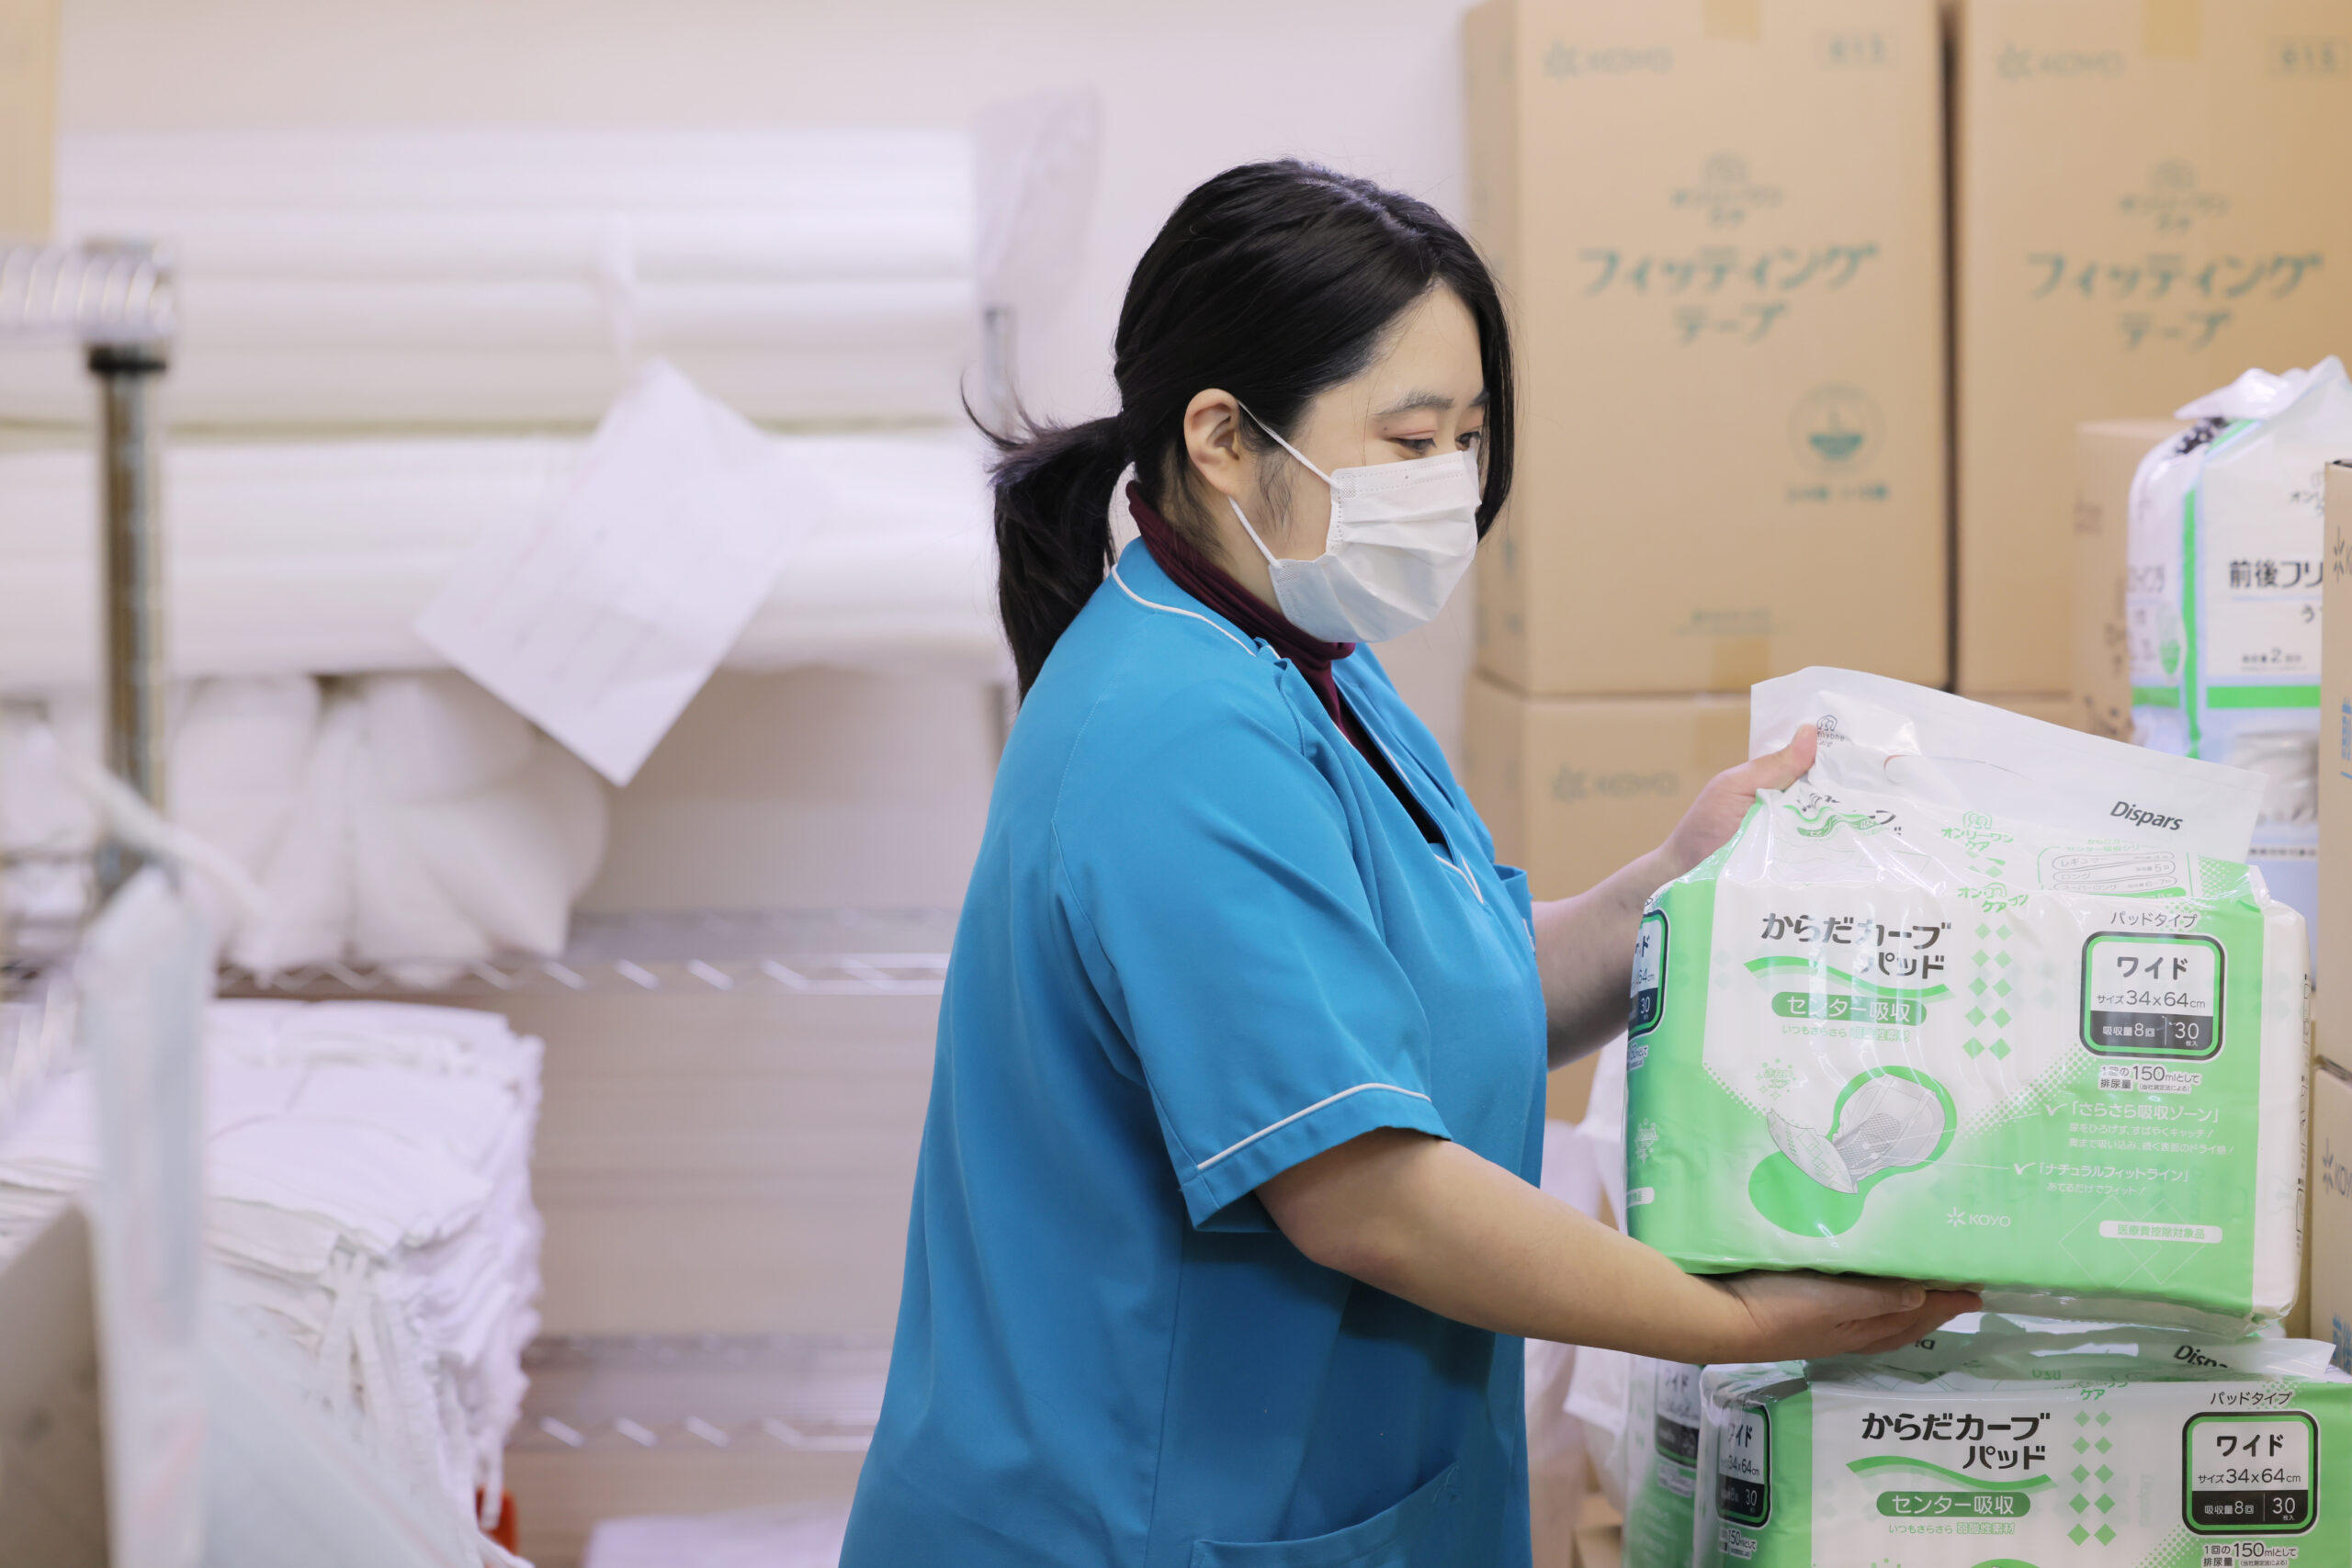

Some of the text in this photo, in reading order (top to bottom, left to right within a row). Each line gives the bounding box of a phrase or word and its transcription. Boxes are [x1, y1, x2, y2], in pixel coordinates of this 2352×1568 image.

[1578, 244, 1879, 296] フィッティング
[2027, 252, 2324, 301] フィッティング
[1673, 301, 1789, 344] テープ
[2121, 310, 2233, 351] テープ
[2109, 800, 2183, 830] Dispars
[1940, 828, 2014, 843] オンリーワン
[1964, 840, 1990, 852] ケア
[1982, 898, 2007, 913] ケア
[2110, 911, 2199, 928] パッドタイプ
[1760, 912, 1952, 951] からだカーブ
[1860, 952, 1945, 980] パッド
[2117, 956, 2188, 981] ワイド
[1787, 995, 1910, 1023] センター吸収
[1781, 1025, 1848, 1037] いつもさらさら
[2102, 1022, 2199, 1040] 吸収量8回 30
[2100, 1078, 2132, 1089] 排尿量
[1969, 1213, 2011, 1227] KOYO
[2080, 1388, 2105, 1401] ケア
[2210, 1391, 2293, 1405] パッドタイプ
[1861, 1412, 2051, 1441] からだカーブ
[2216, 1434, 2284, 1458] ワイド
[1962, 1445, 2046, 1471] パッド
[1892, 1495, 2015, 1515] センター吸収
[2204, 1497, 2296, 1516] 吸収量8回 30
[1888, 1524, 1953, 1535] いつもさらさら
[2204, 1546, 2231, 1556] 1回の
